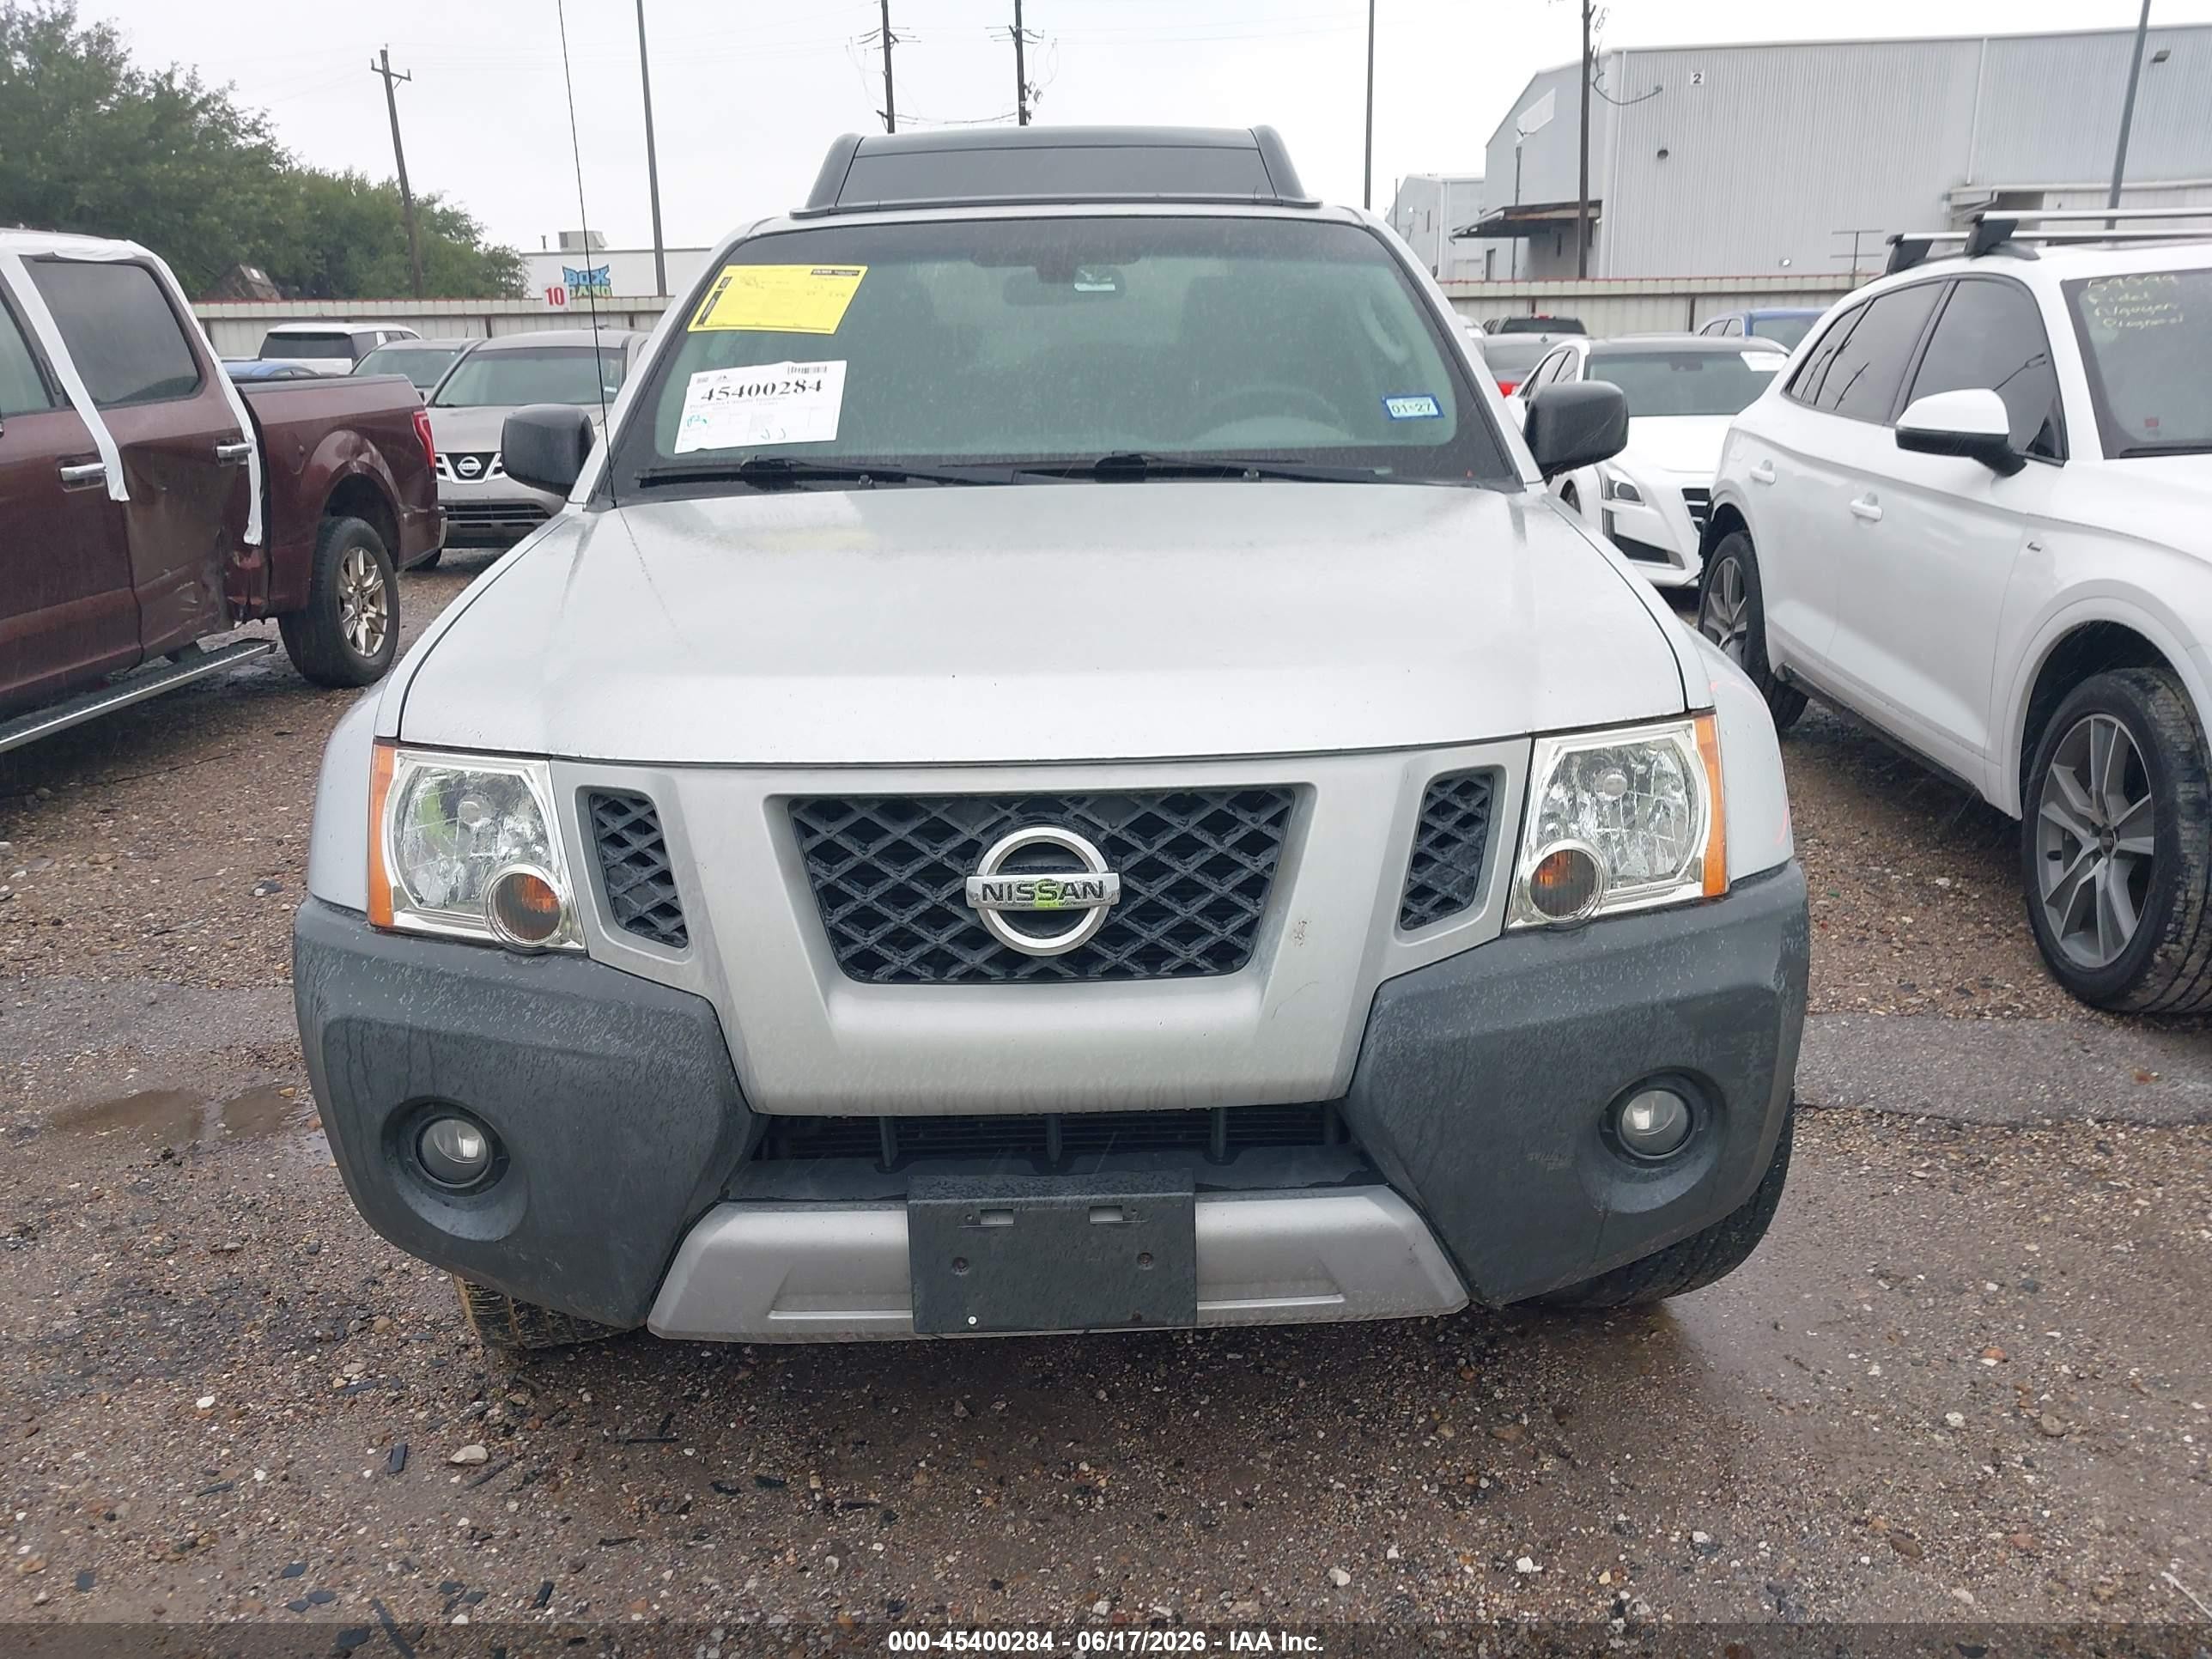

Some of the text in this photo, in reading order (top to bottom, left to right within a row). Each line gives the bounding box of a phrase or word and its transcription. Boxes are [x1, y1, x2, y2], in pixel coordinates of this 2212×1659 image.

[1693, 73, 1702, 84] 2
[562, 264, 611, 285] BOX
[545, 287, 565, 306] 10
[701, 379, 823, 402] 45400284
[981, 879, 1104, 902] NISSAN
